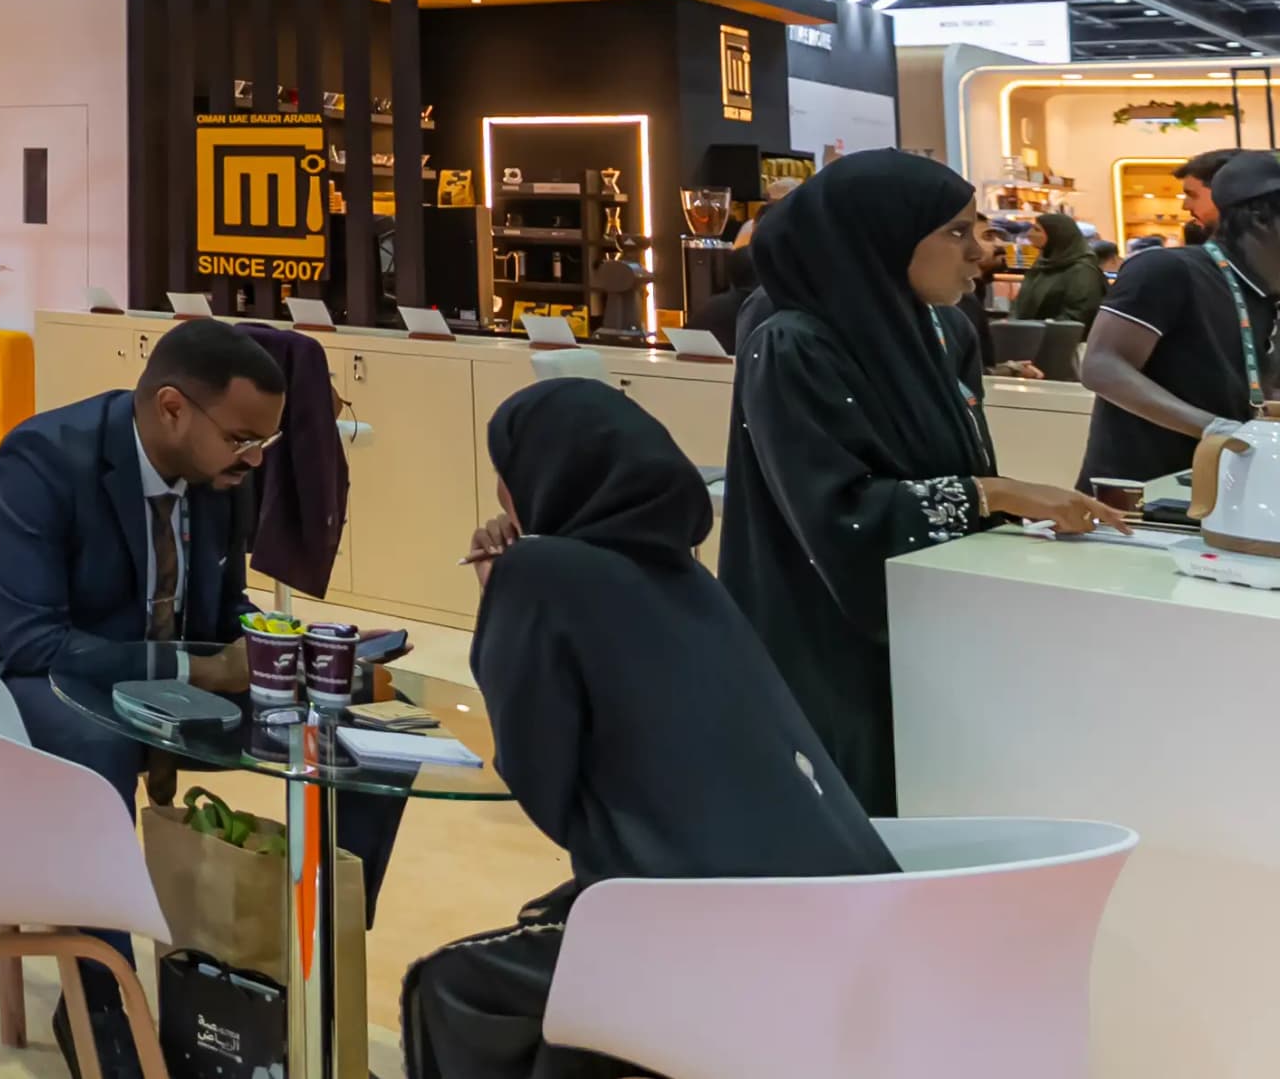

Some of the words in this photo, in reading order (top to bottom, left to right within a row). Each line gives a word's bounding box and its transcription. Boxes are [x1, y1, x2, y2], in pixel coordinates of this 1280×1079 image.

[196, 113, 226, 124] OMAN
[228, 113, 249, 124] UAE
[250, 113, 282, 124] SAUDI
[283, 113, 323, 124] ARABIA
[198, 255, 266, 277] SINCE
[271, 259, 325, 281] 2007
